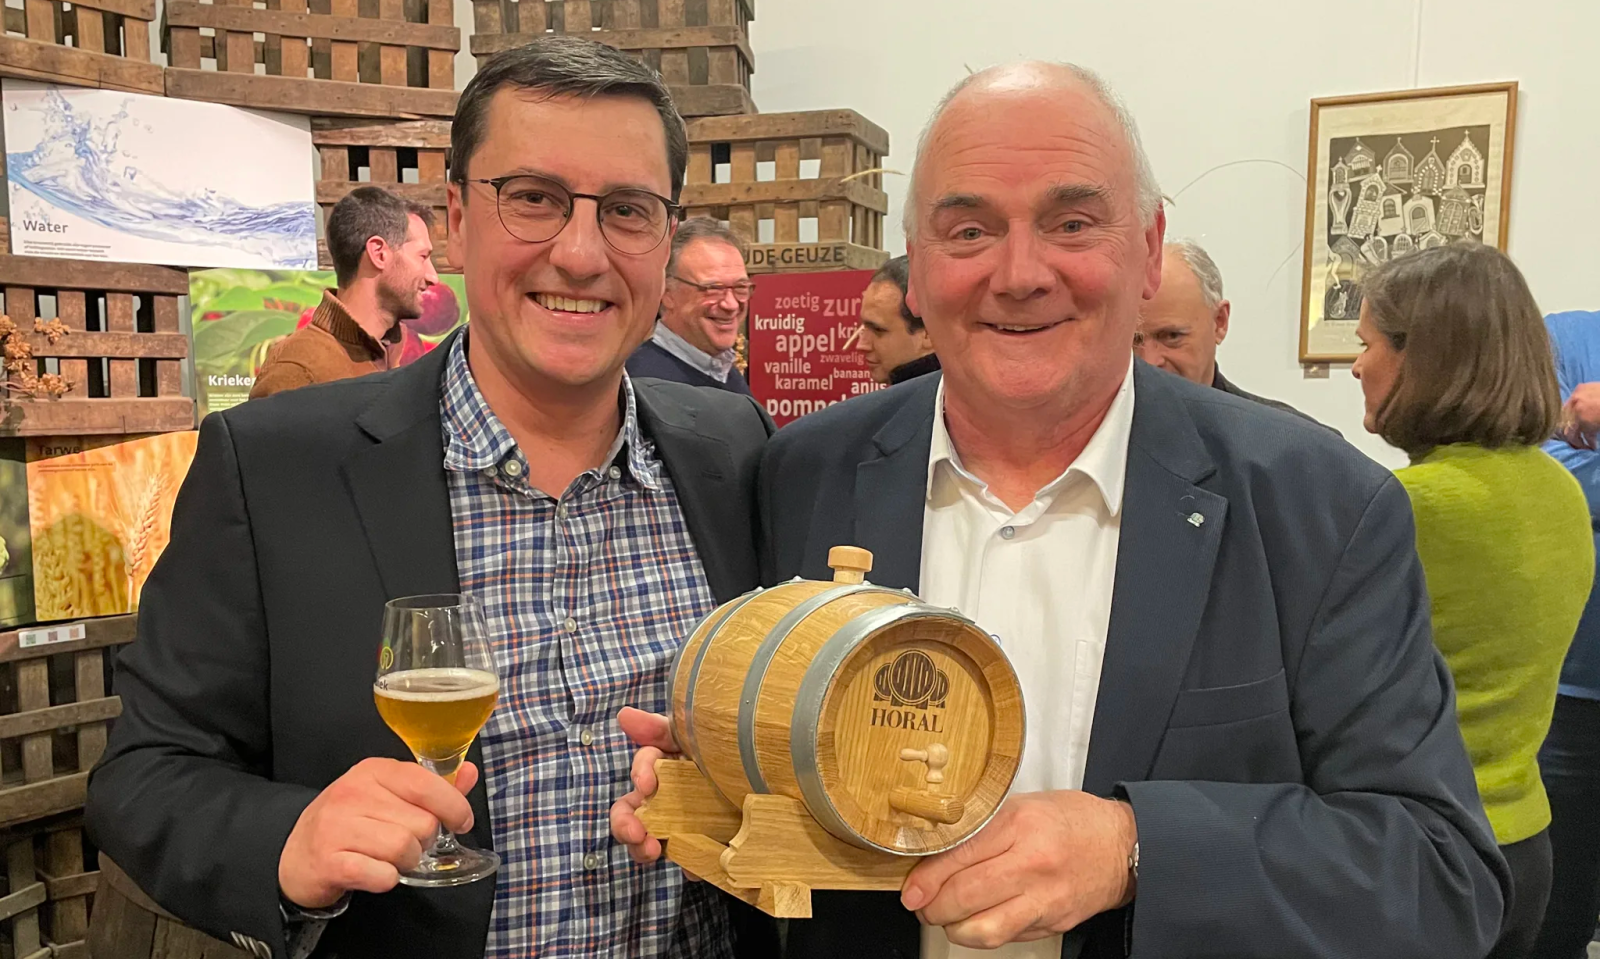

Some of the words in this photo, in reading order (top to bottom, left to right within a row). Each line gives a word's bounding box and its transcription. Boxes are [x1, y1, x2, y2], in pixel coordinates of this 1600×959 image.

[23, 220, 69, 234] Water
[774, 291, 820, 312] zoetig
[754, 313, 806, 334] kruidig
[775, 327, 835, 358] appel
[764, 357, 811, 374] vanille
[820, 351, 865, 366] zwavelig
[833, 367, 871, 379] banaan
[774, 374, 833, 390] karamel
[766, 393, 847, 417] pomp
[37, 444, 81, 456] Tarwe
[871, 707, 944, 733] HORAL
